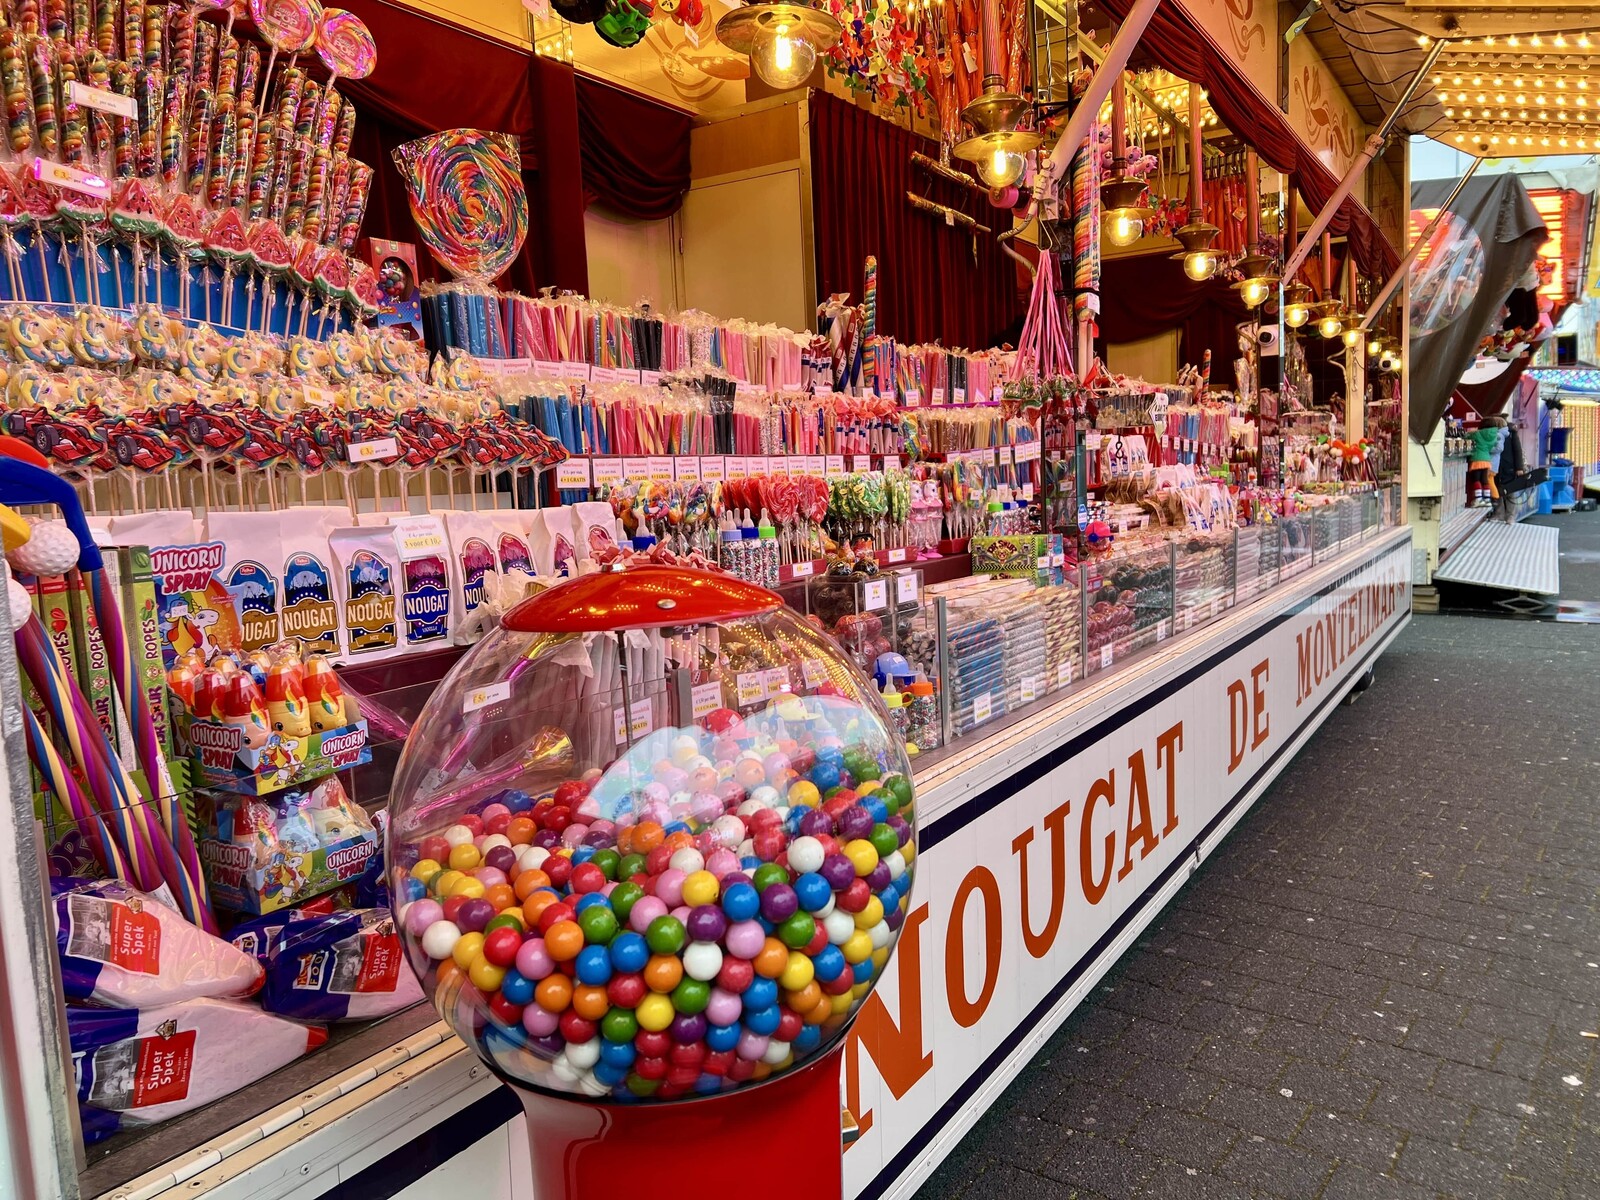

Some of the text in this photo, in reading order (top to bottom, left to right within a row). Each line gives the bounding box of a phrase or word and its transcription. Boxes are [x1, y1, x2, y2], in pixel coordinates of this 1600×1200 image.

[150, 546, 221, 574] UNICORN
[164, 570, 212, 594] SPRAY
[347, 601, 394, 624] NOUGAT
[405, 593, 448, 616] NOUGAT
[284, 606, 334, 632] NOUGAT
[87, 626, 104, 670] ROPES
[142, 617, 158, 660] ROPES
[191, 724, 241, 751] UNICORN
[322, 730, 365, 756] UNICORN
[203, 749, 234, 771] SPRAY
[332, 750, 361, 768] SPRAY
[202, 840, 249, 869] UNICORN
[328, 841, 373, 869] UNICORN
[843, 566, 1396, 1155] NOUGAT DE MONTELIMAR
[212, 865, 241, 889] SPRAY
[337, 858, 366, 880] SPRAY
[120, 920, 133, 956] Super
[131, 926, 145, 955] Spek
[369, 945, 383, 980] Super
[377, 948, 391, 977] Spek
[147, 1050, 163, 1091] Super
[160, 1050, 176, 1086] Spek
